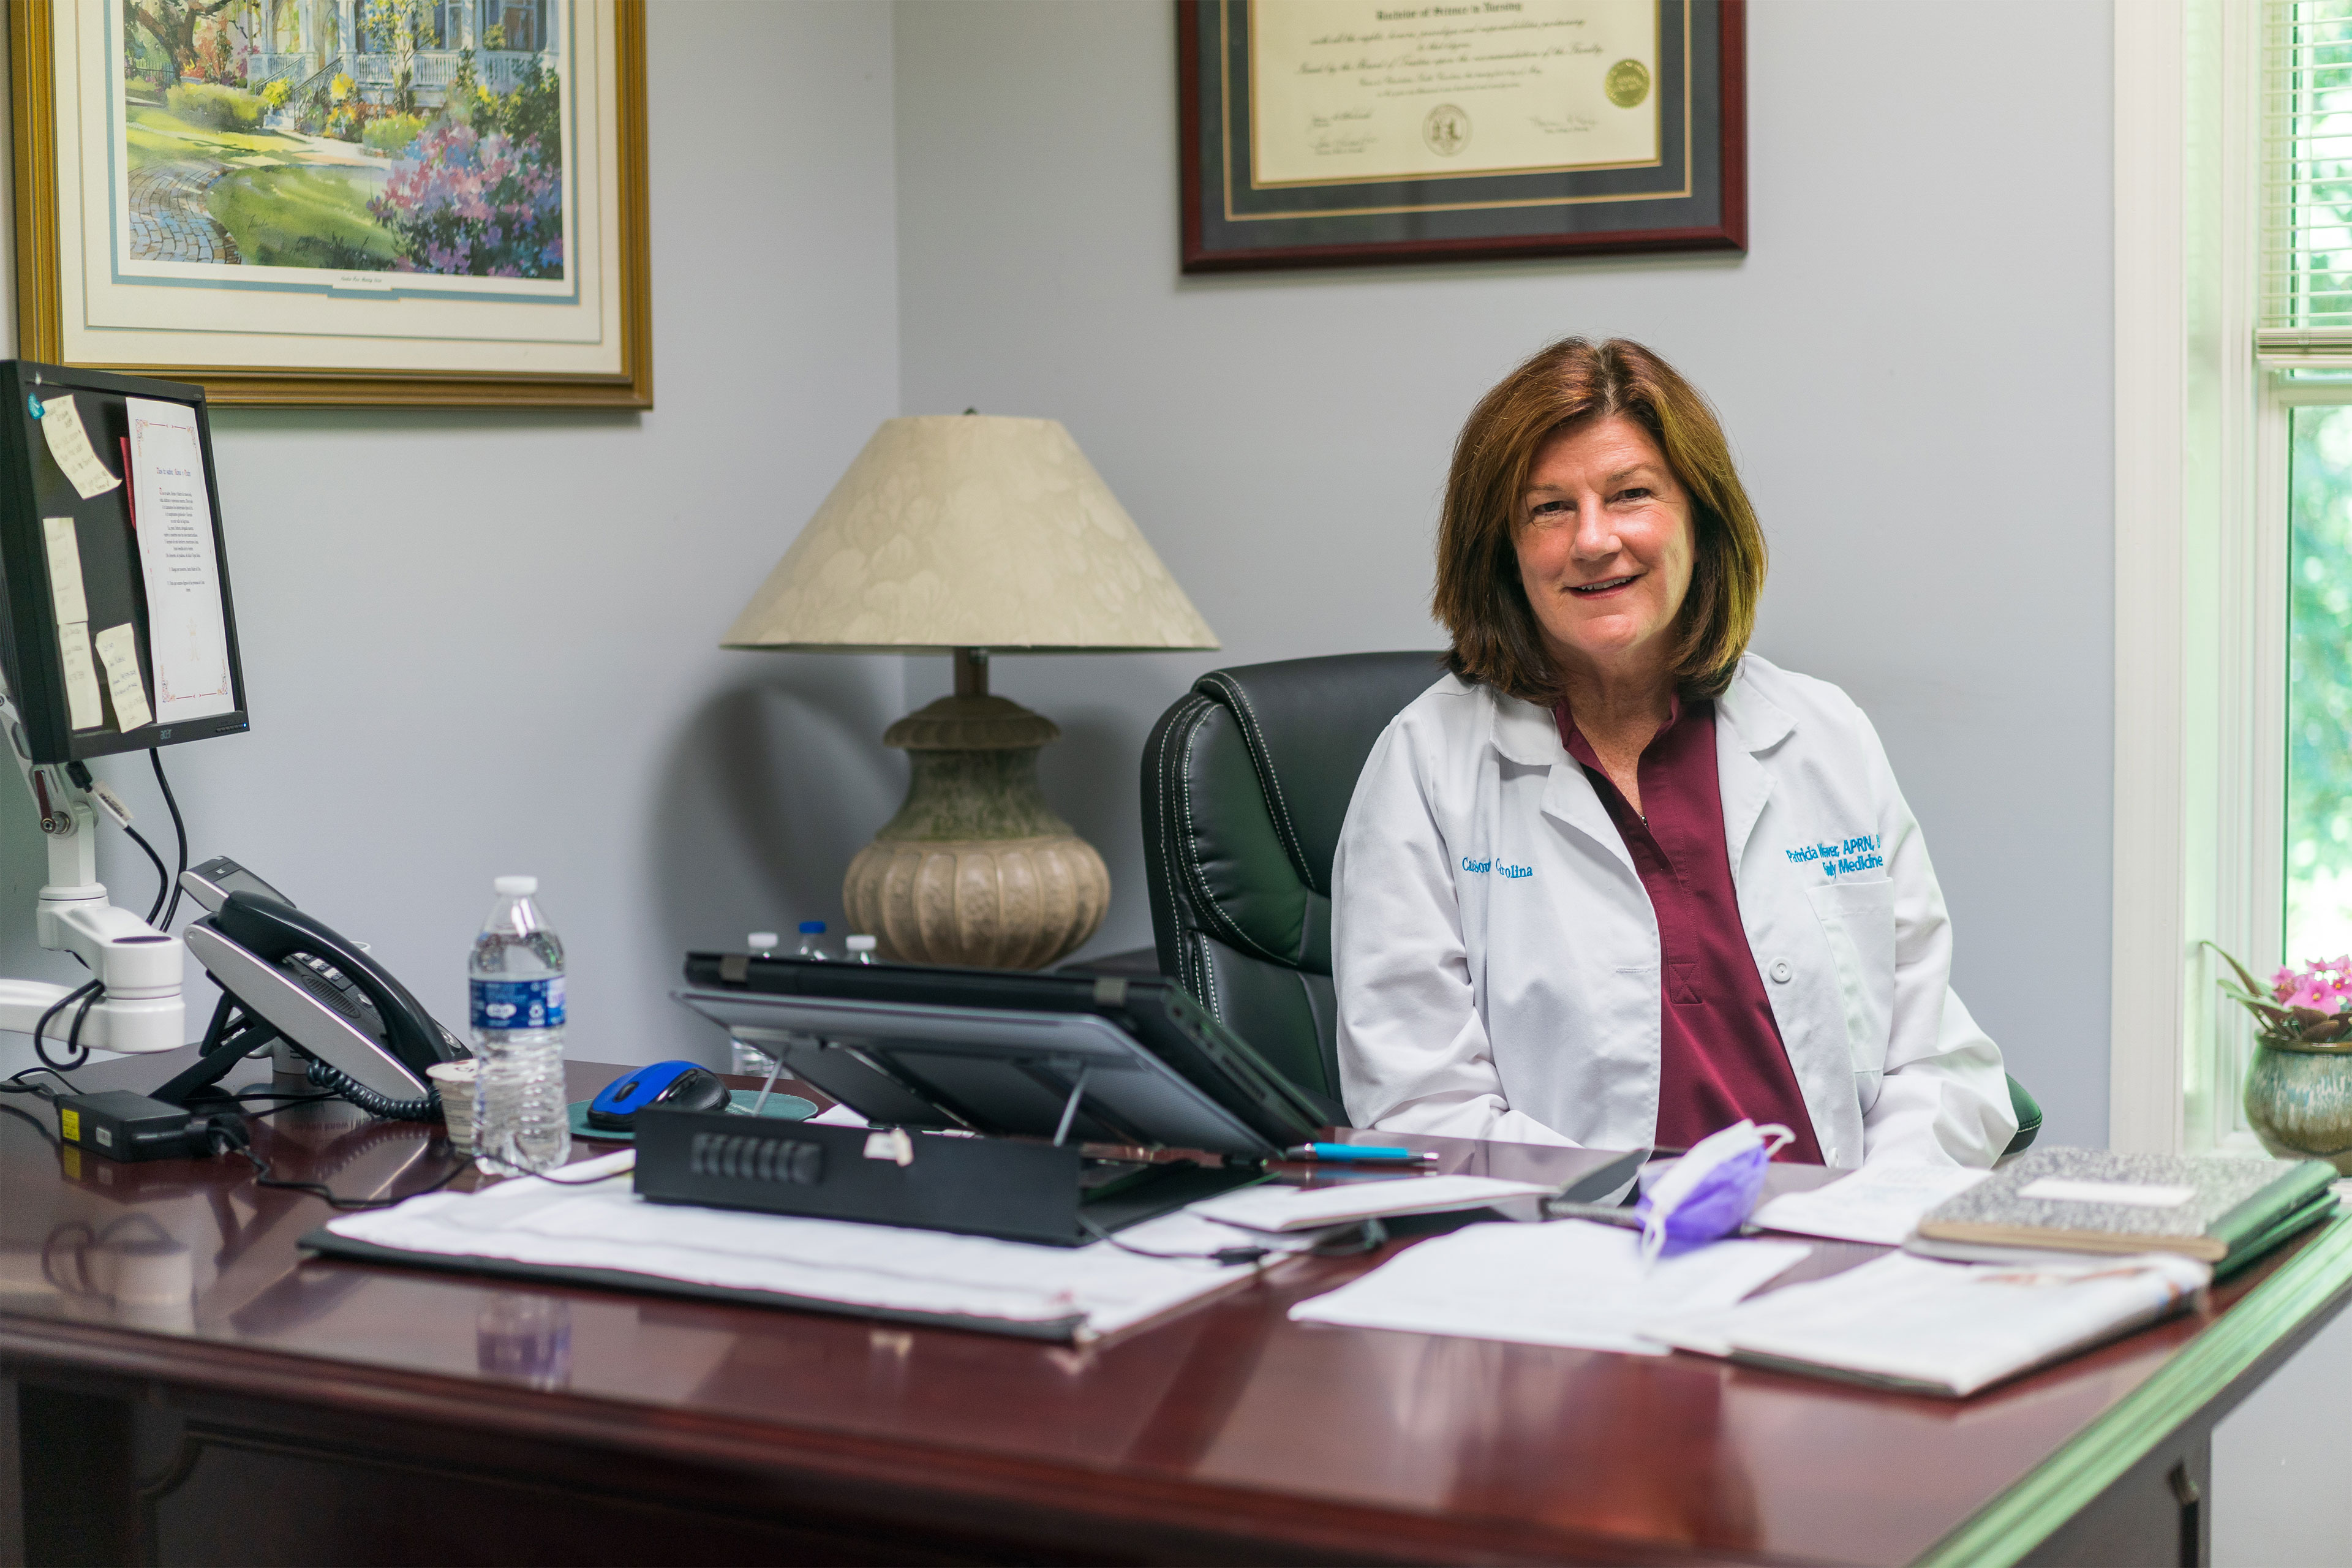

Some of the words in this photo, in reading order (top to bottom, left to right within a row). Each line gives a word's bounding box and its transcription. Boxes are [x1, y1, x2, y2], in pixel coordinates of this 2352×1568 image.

[160, 729, 172, 740] acer
[1785, 846, 1819, 863] Patricia
[1844, 835, 1875, 855] APRN,
[1838, 854, 1883, 874] Medicine
